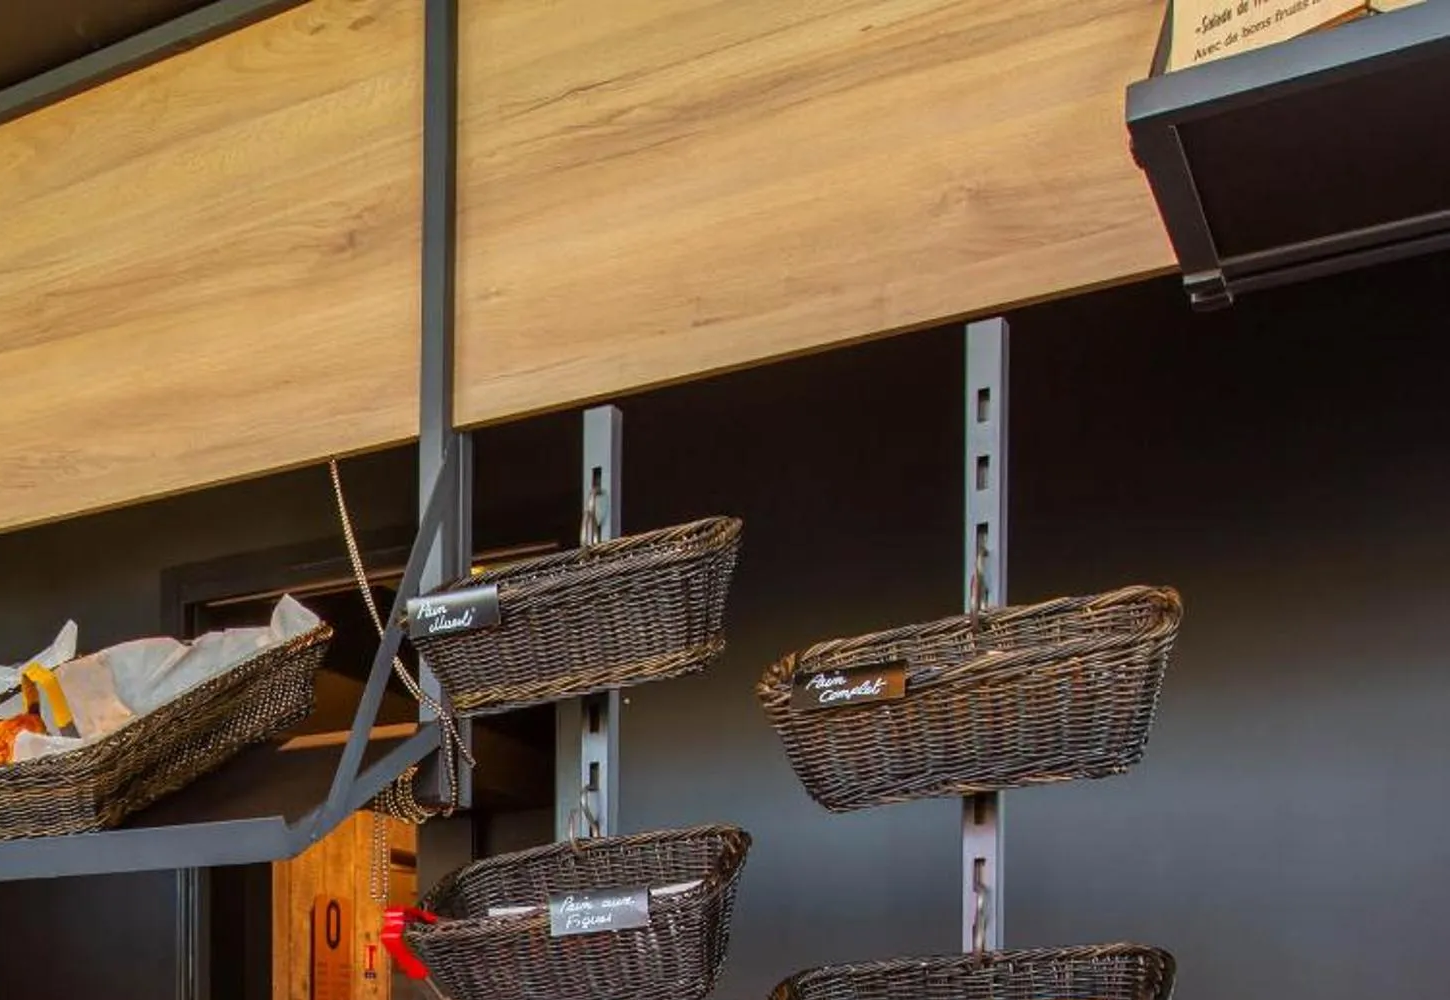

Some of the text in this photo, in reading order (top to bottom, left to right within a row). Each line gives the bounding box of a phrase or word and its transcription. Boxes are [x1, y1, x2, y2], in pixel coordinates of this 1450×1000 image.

[1193, 1, 1309, 60] Avec de bons fruits
[806, 671, 847, 690] Pain
[559, 895, 592, 913] Pain
